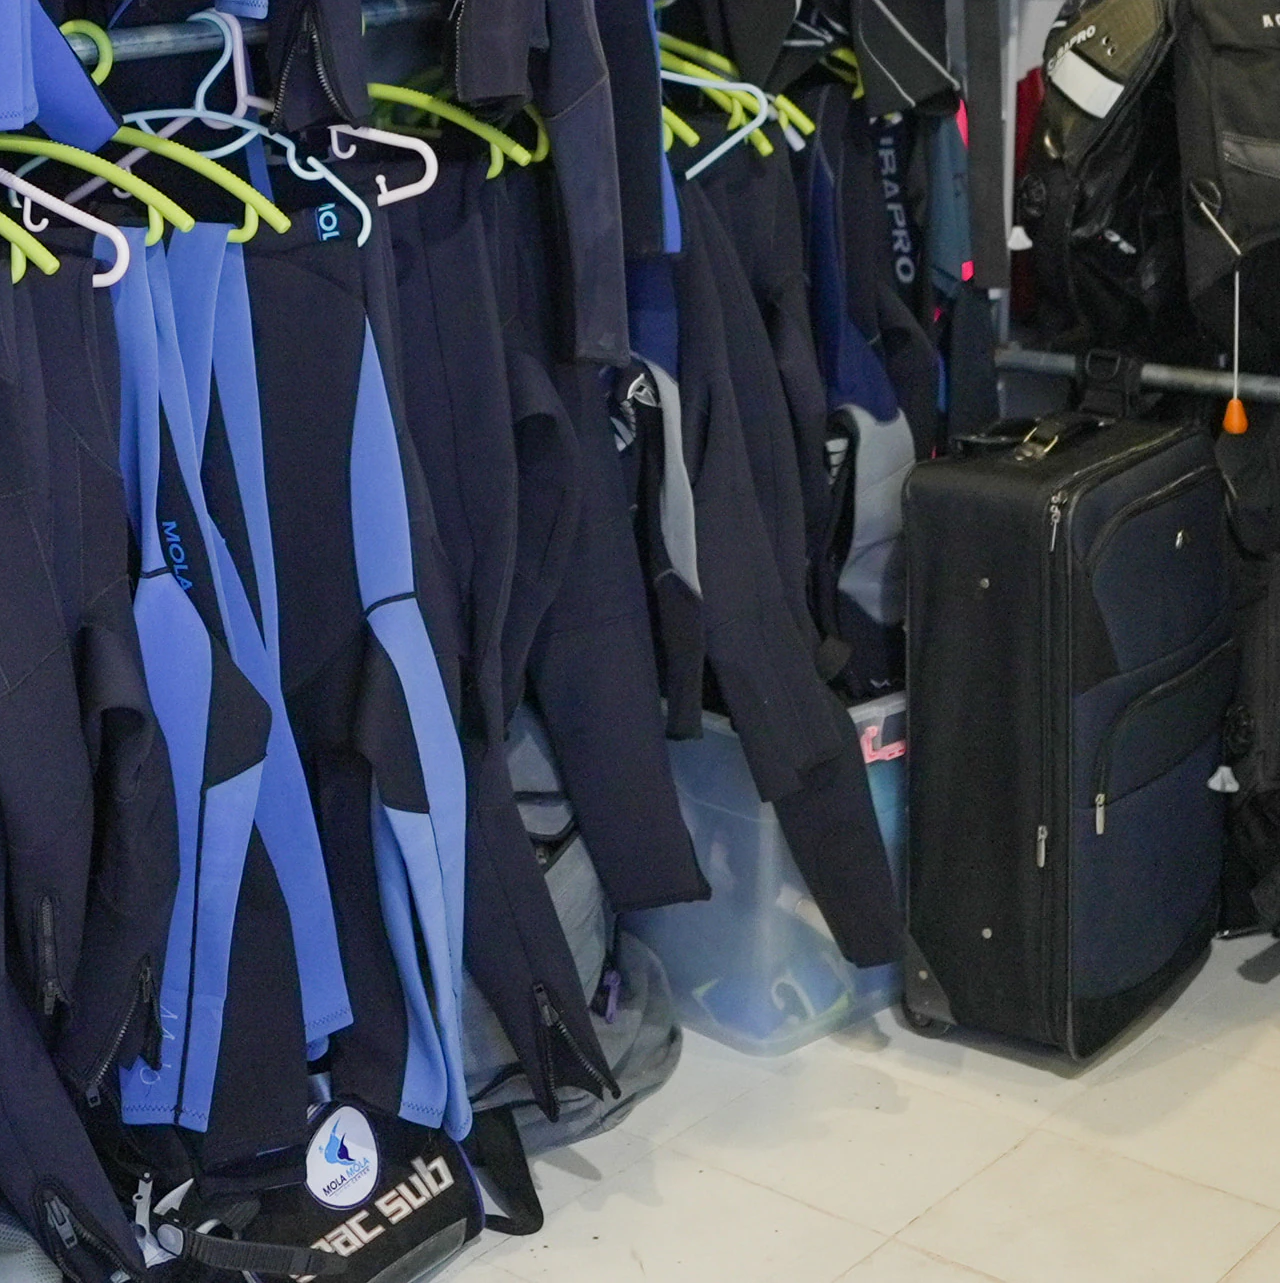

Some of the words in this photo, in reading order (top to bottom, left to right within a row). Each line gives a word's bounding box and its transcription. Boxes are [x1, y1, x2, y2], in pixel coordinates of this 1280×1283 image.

[162, 521, 193, 590] MOLA
[322, 1174, 347, 1197] MOLA
[345, 1157, 370, 1179] MOLA
[374, 1155, 455, 1225] sub
